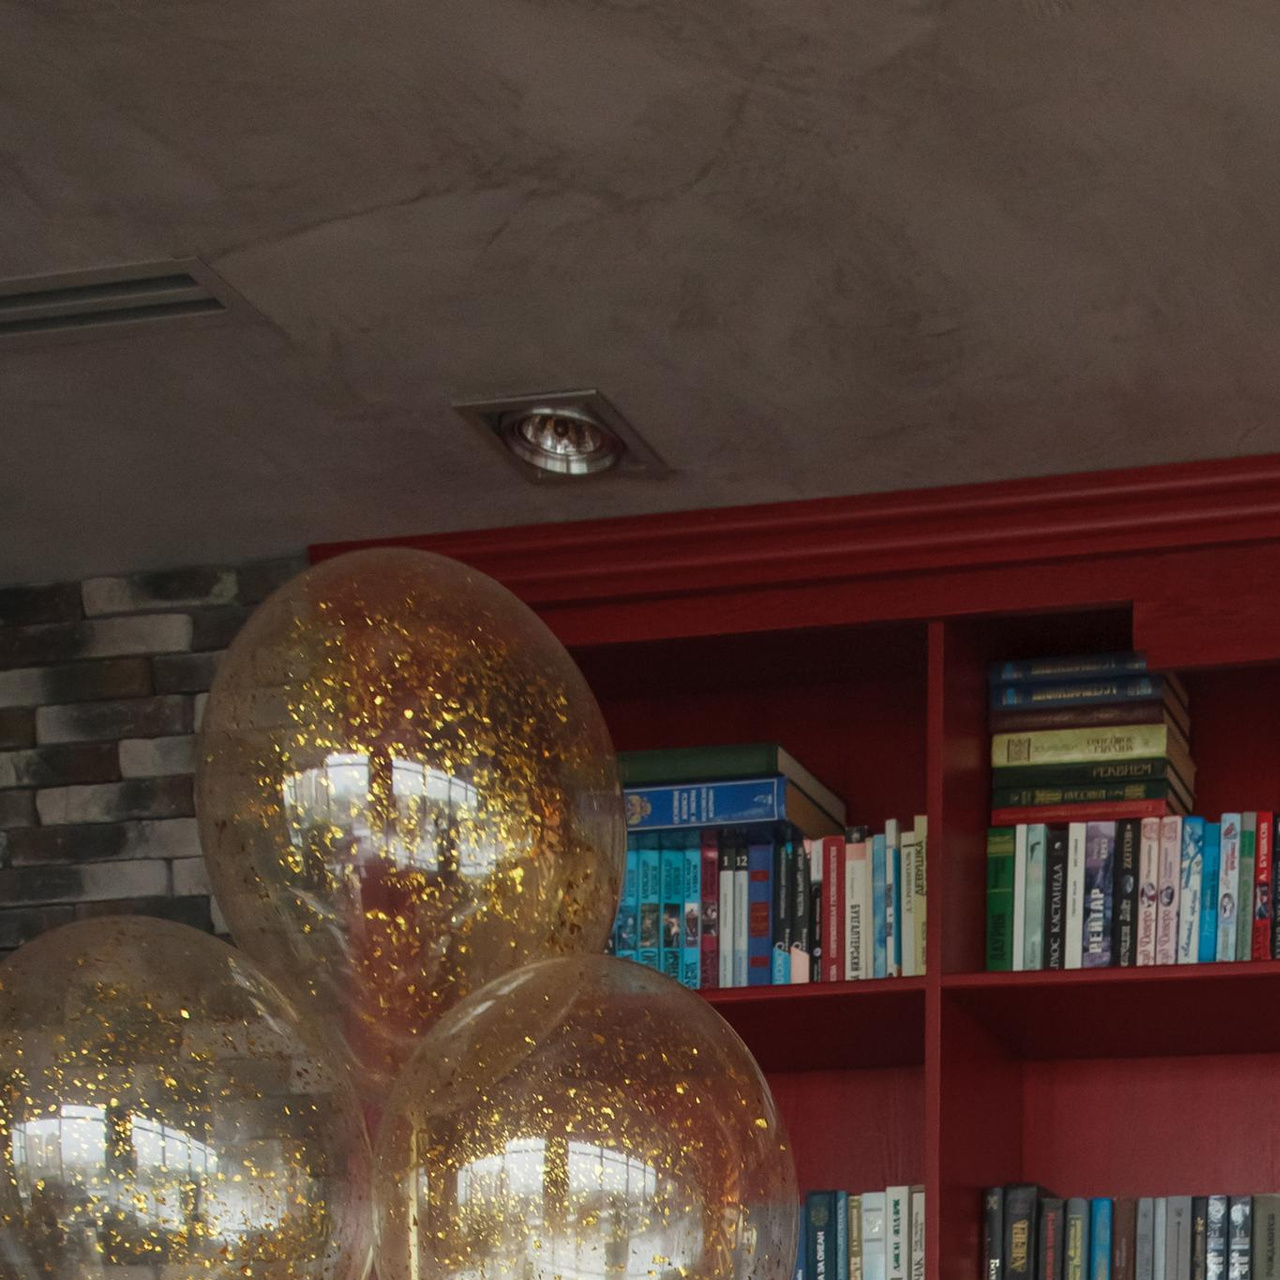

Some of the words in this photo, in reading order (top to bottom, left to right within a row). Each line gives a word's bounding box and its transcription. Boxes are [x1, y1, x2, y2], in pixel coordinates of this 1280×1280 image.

[723, 856, 728, 866] 1
[736, 856, 748, 866] 12
[1260, 822, 1268, 867] БУШКОВ
[915, 841, 926, 896] ДЕВУШКА
[1051, 863, 1062, 933] КАСТАНЕДА
[851, 904, 861, 972] БУХГАЛТЕРСКИЙ
[817, 1231, 825, 1260] ОКЕАН
[817, 1261, 825, 1272] ЗА
[1266, 1213, 1275, 1277] РОЖДАЮТСЯ
